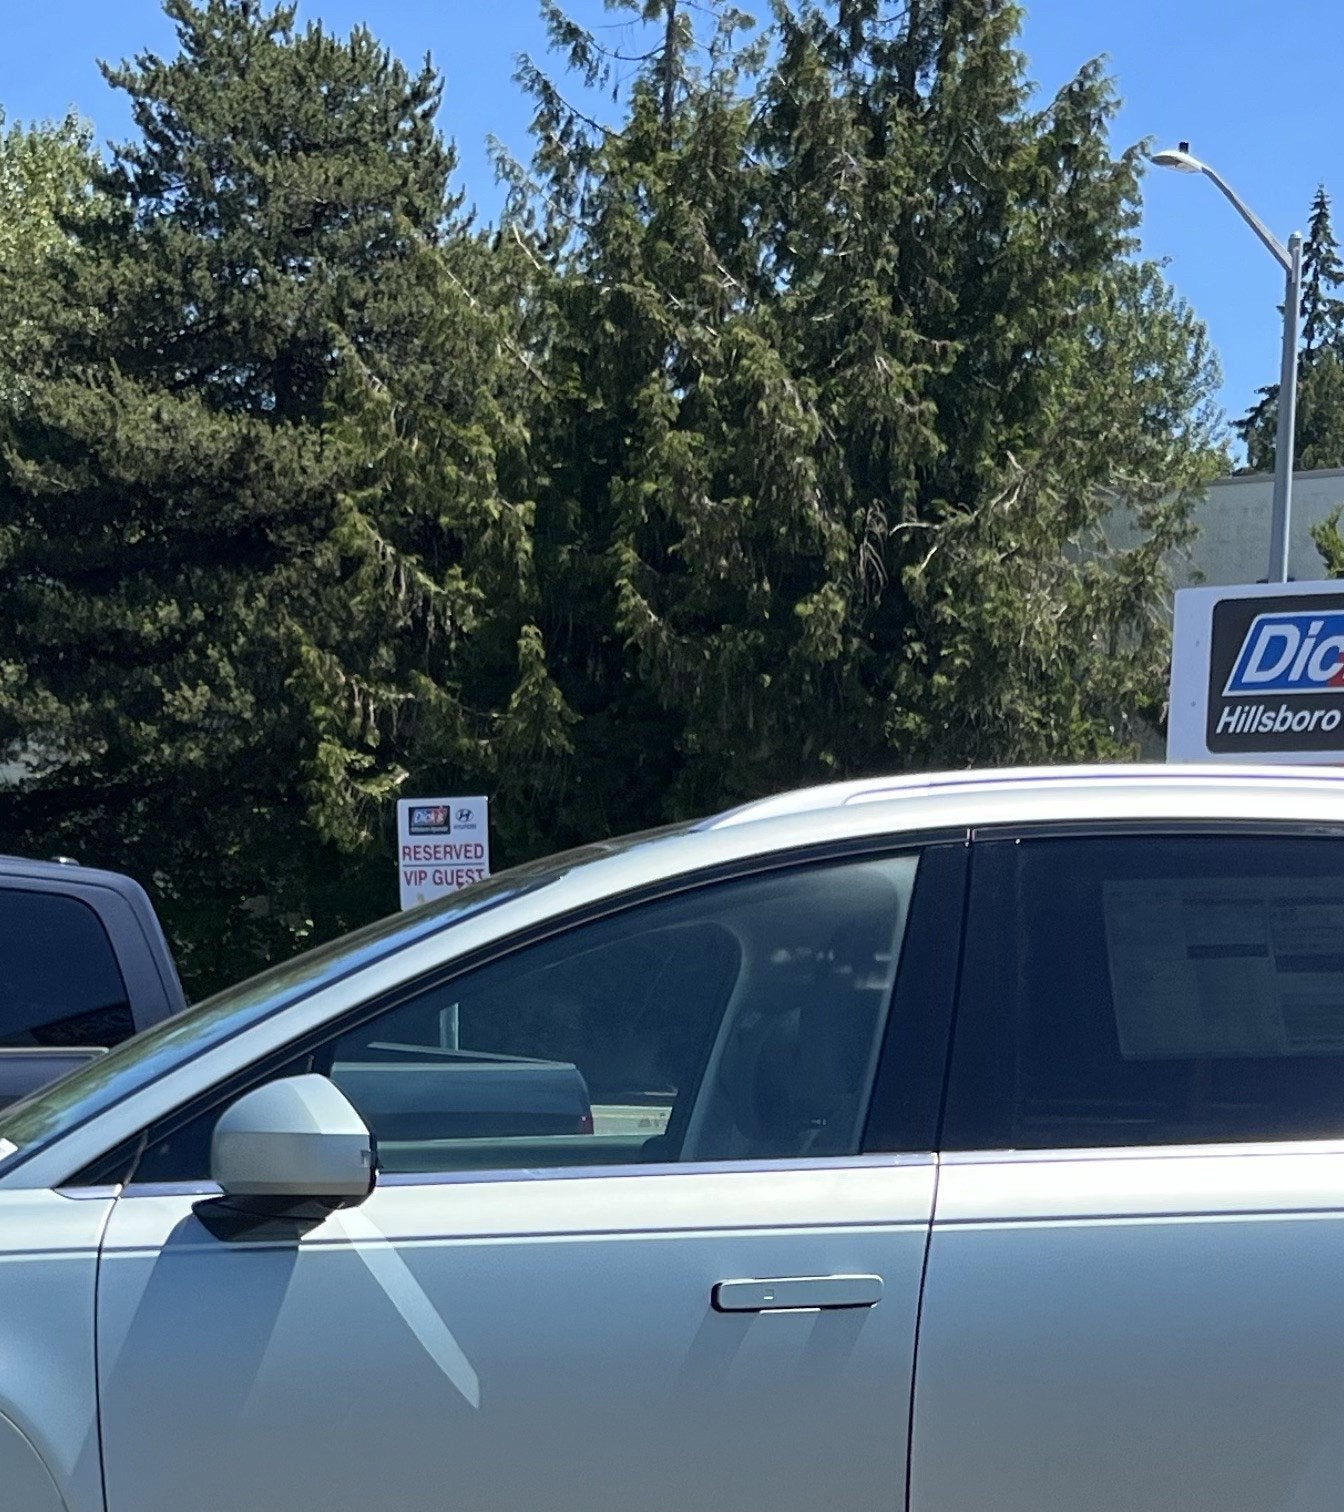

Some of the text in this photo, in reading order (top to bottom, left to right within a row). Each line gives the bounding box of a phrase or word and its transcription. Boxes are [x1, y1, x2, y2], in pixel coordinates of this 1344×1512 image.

[1215, 703, 1342, 735] Hillsboro
[401, 843, 485, 861] RESERVED
[403, 868, 485, 887] VIP GUEST
